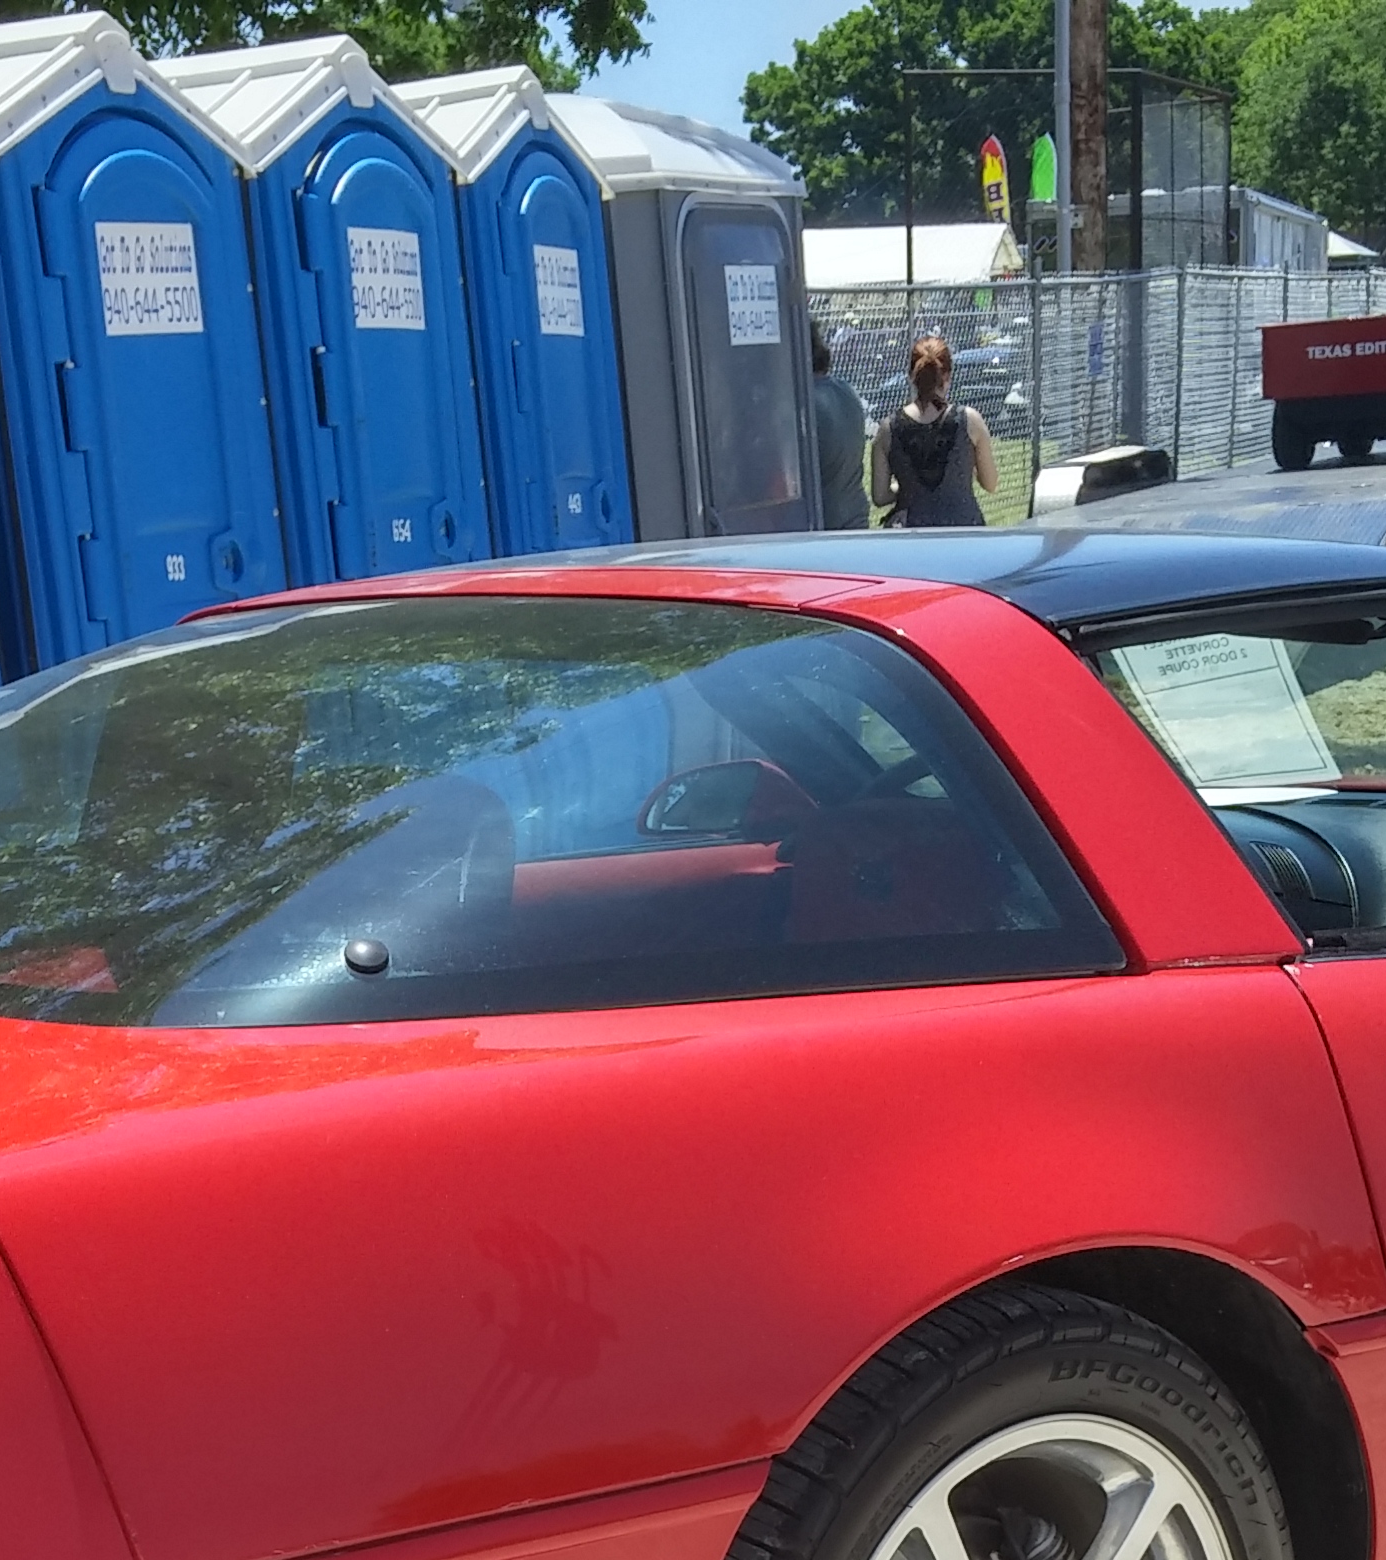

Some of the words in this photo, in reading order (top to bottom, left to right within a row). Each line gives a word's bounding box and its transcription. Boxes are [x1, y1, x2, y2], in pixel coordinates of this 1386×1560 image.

[100, 235, 116, 274] Got
[120, 236, 130, 274] To
[134, 235, 145, 274] Go
[150, 233, 192, 274] Solutions
[104, 286, 198, 325] 940-644-5500
[1306, 343, 1352, 360] TEXAS
[166, 554, 186, 581] 933
[1047, 1358, 1259, 1506] BFGoodrich
